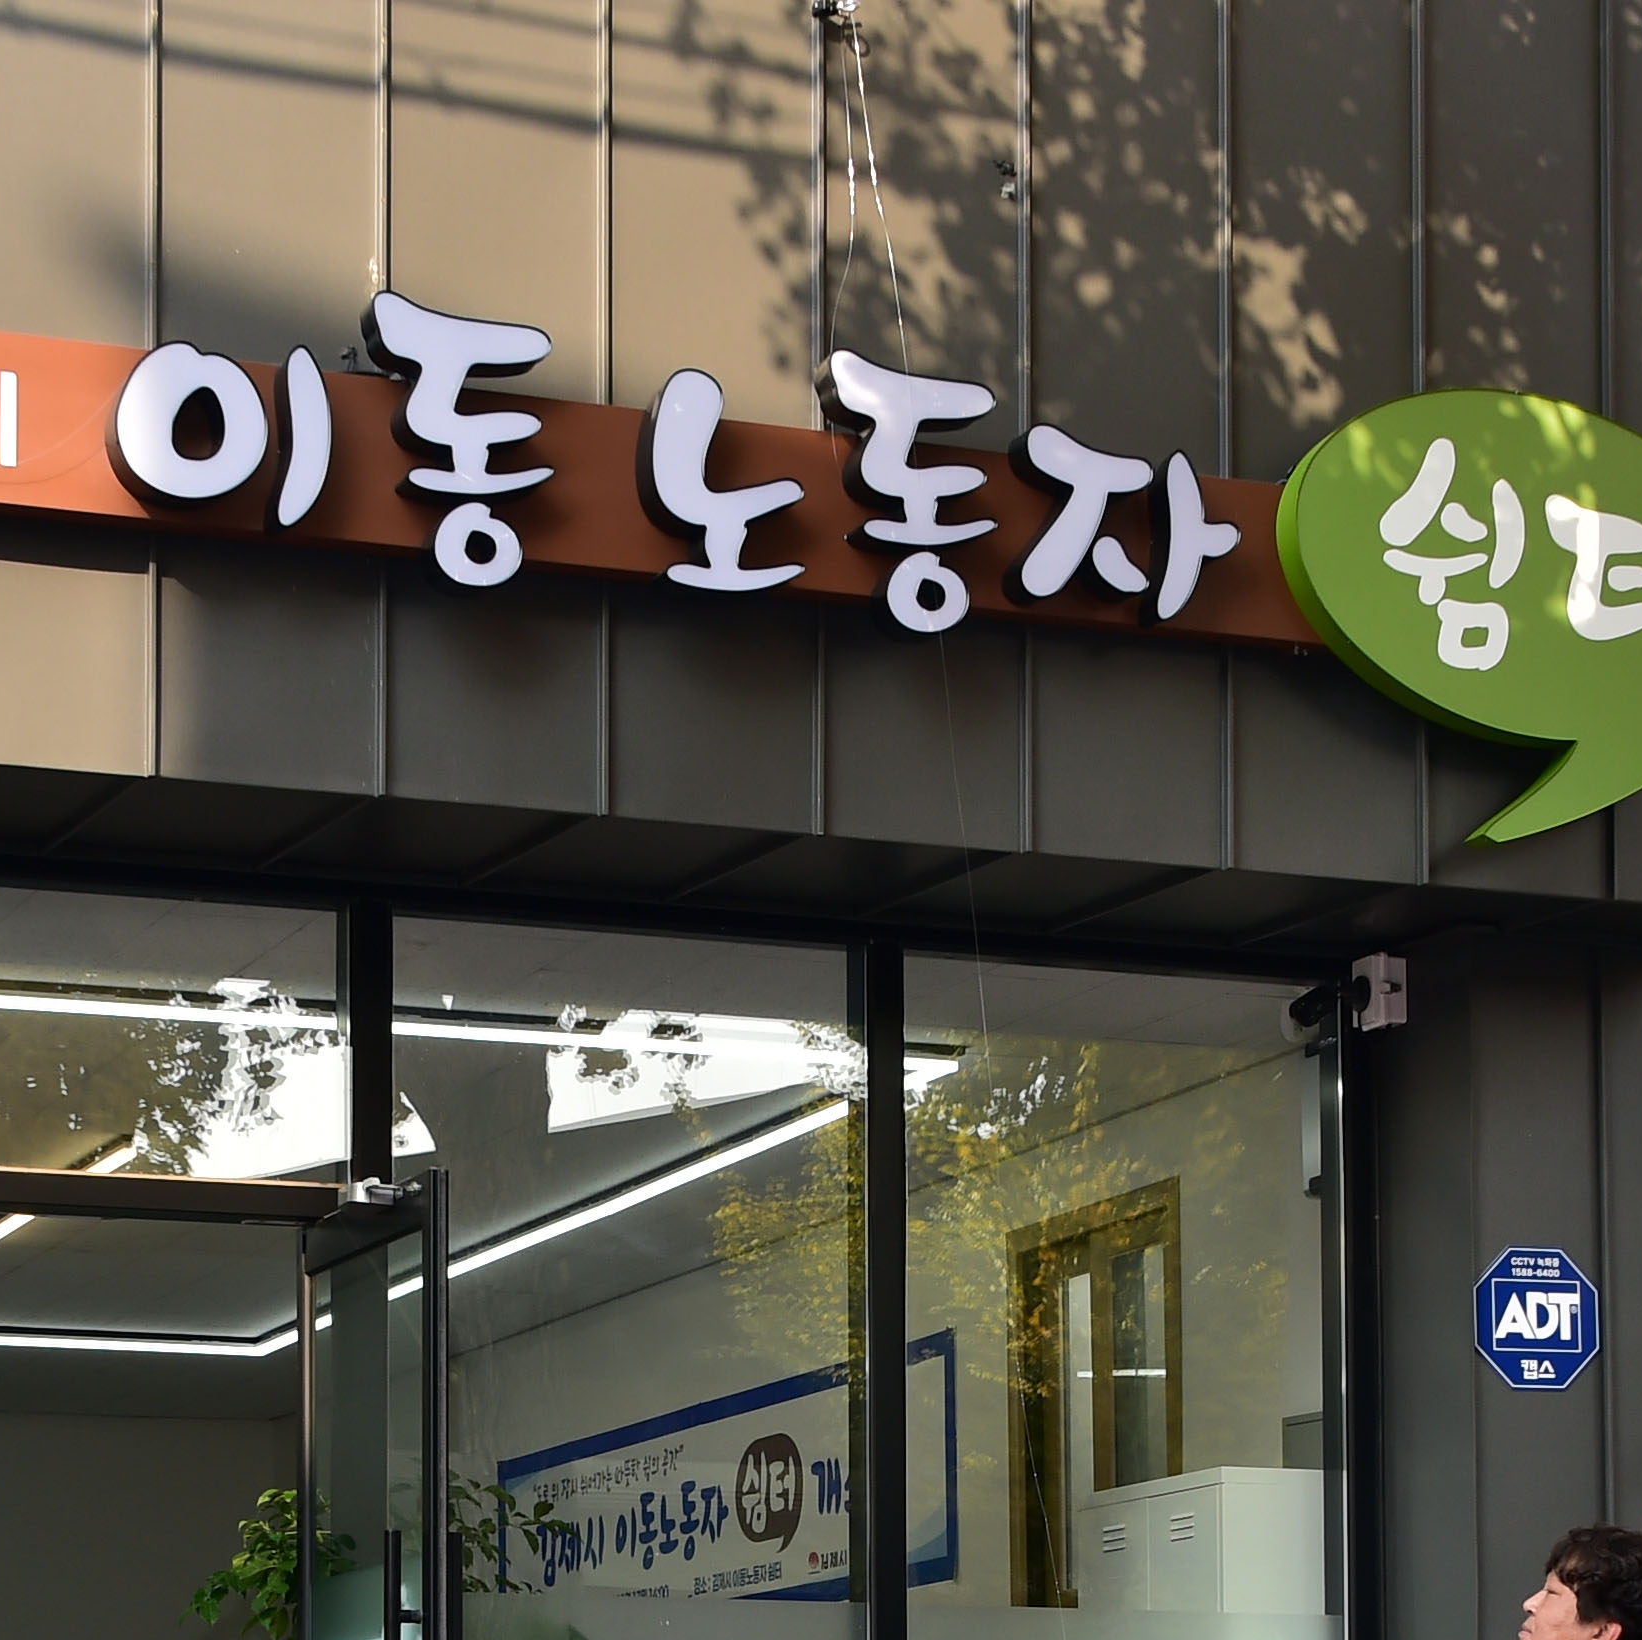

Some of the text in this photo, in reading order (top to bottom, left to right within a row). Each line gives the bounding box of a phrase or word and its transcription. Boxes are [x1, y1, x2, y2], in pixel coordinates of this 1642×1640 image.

[111, 290, 555, 588] 이동
[647, 347, 1244, 635] 노동자
[1510, 1256, 1560, 1268] CCTV 녹화중
[1511, 1267, 1561, 1278] 1588-6400
[1495, 1290, 1580, 1341] ADT
[1520, 1359, 1556, 1380] 캡스
[614, 1458, 641, 1487] 따뜻한
[615, 1480, 729, 1571] 이동노동자
[741, 1450, 796, 1534] 쉼터
[810, 1457, 850, 1515] 개
[712, 1570, 732, 1593] 김제시
[732, 1564, 767, 1588] 이동노동자
[767, 1560, 783, 1582] 쉼터
